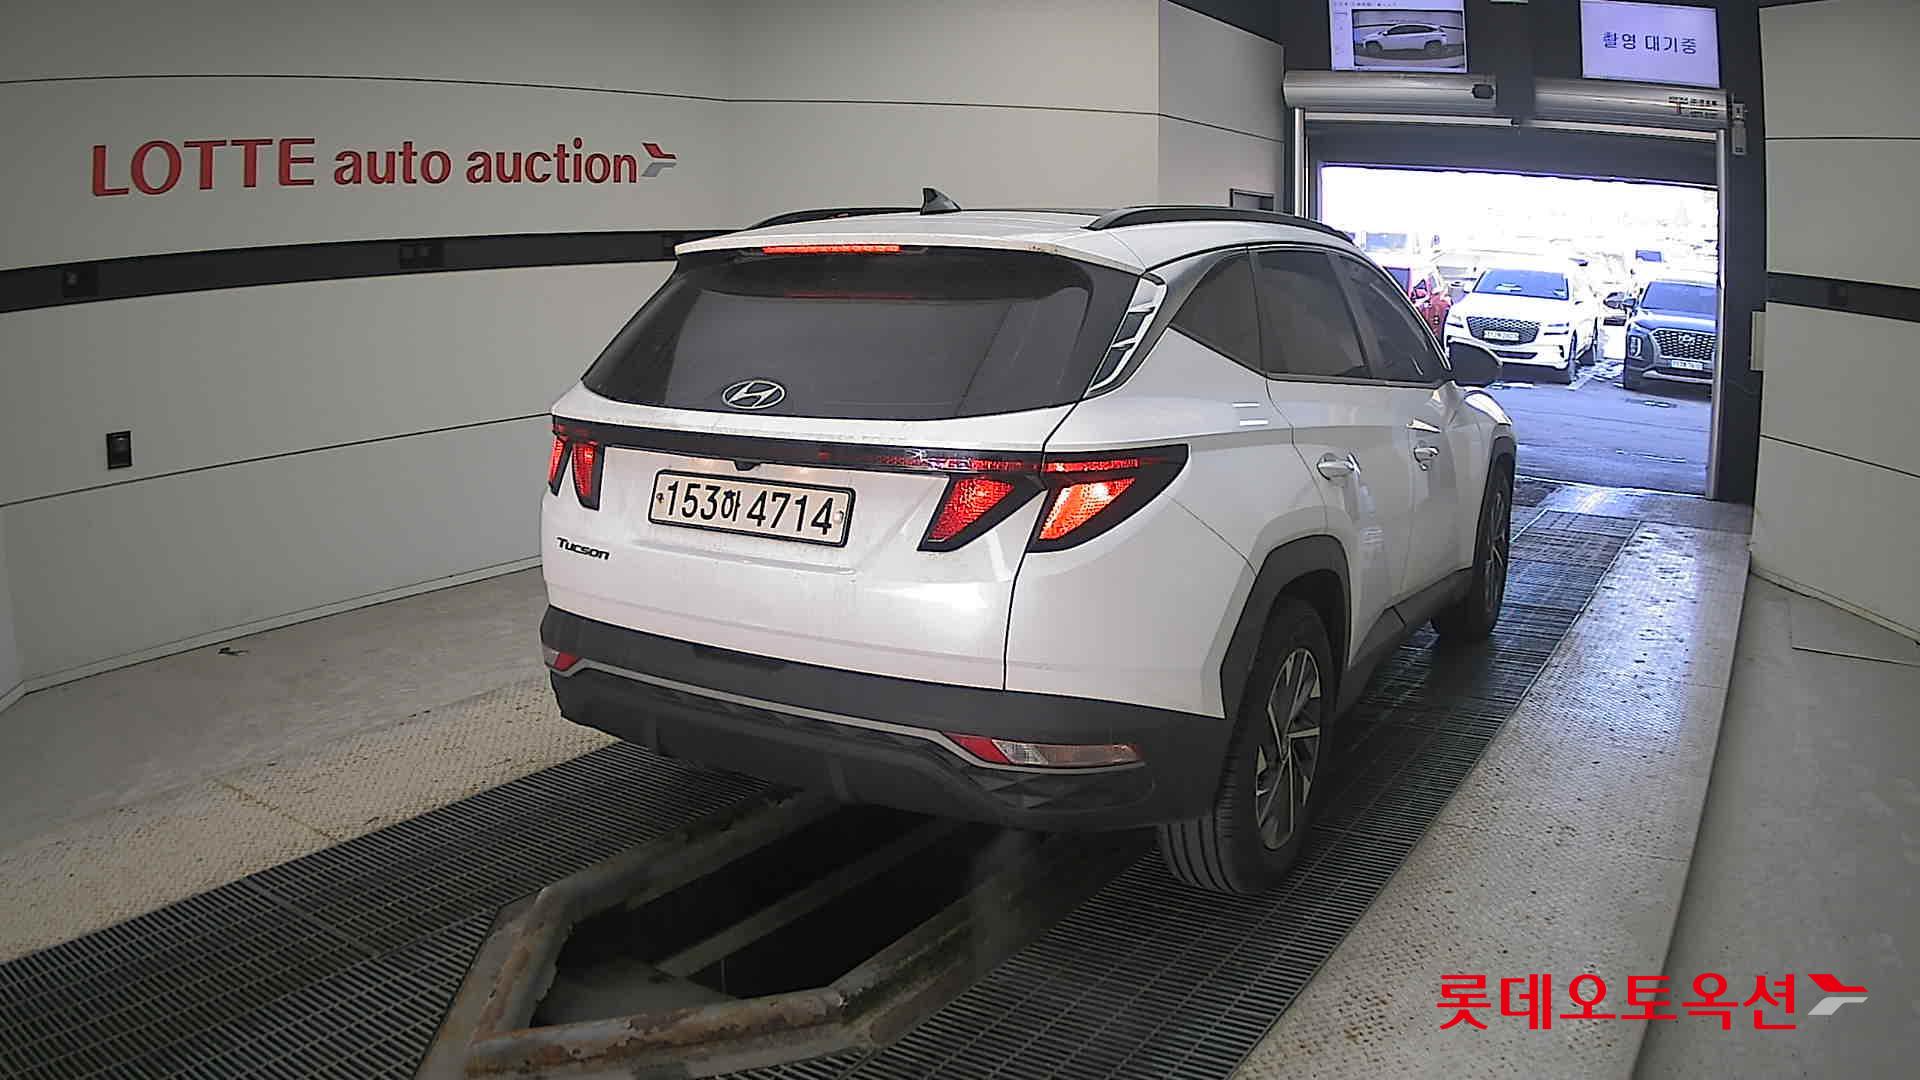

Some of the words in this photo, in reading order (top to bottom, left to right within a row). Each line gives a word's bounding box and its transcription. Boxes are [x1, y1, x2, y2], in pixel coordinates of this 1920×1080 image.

[1644, 35, 1697, 55] 대기중
[92, 138, 315, 196] LOTTE
[334, 141, 452, 185] auto
[466, 137, 638, 184] auction
[667, 480, 741, 522] 153하
[746, 490, 835, 535] 4714
[556, 536, 610, 560] Tucson
